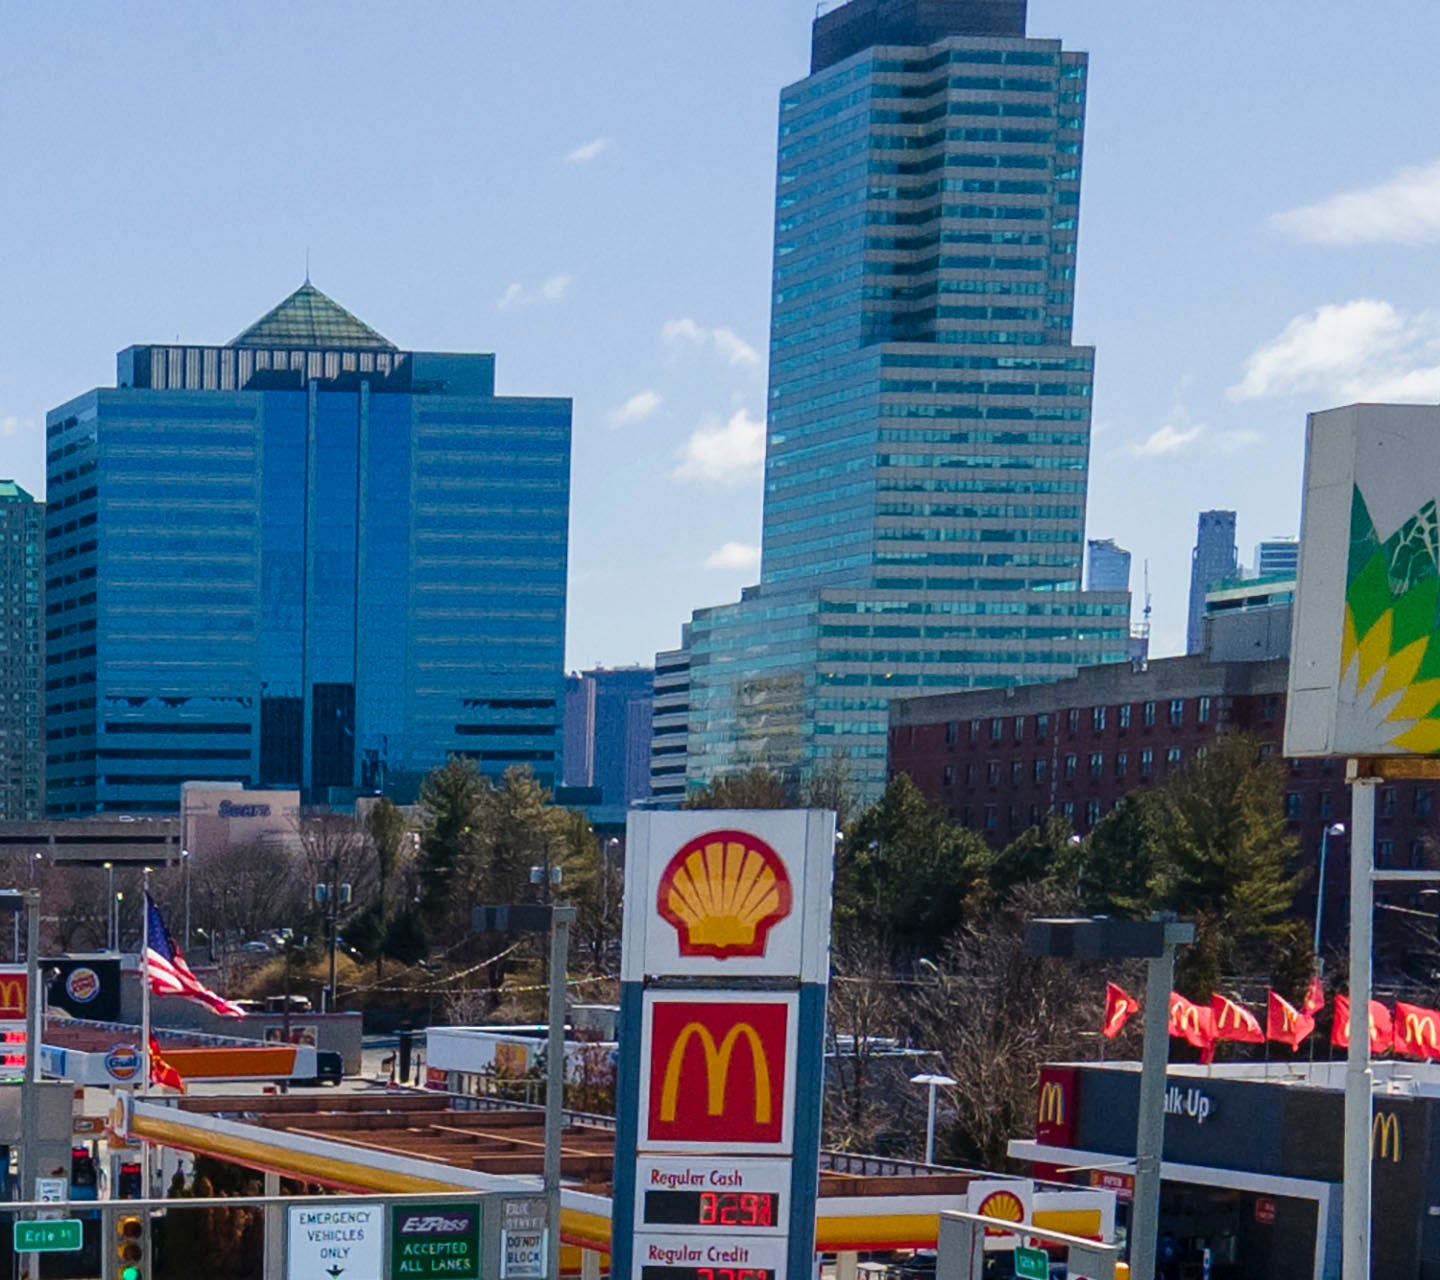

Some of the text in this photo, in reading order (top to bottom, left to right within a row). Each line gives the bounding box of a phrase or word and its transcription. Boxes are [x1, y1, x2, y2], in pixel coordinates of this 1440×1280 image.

[1163, 1086, 1210, 1124] lk Up
[650, 1169, 743, 1189] Regular Cash
[299, 1212, 370, 1225] EMERGENCY
[25, 1229, 55, 1242] Erie
[307, 1229, 365, 1242] VEHICLES
[404, 1242, 468, 1255] ACCEPTED
[507, 1236, 540, 1249] DO NOT
[320, 1248, 350, 1259] ONLY
[507, 1251, 540, 1264] BLOCK
[648, 1244, 750, 1264] Regular Credit
[400, 1259, 471, 1272] ALL LANES
